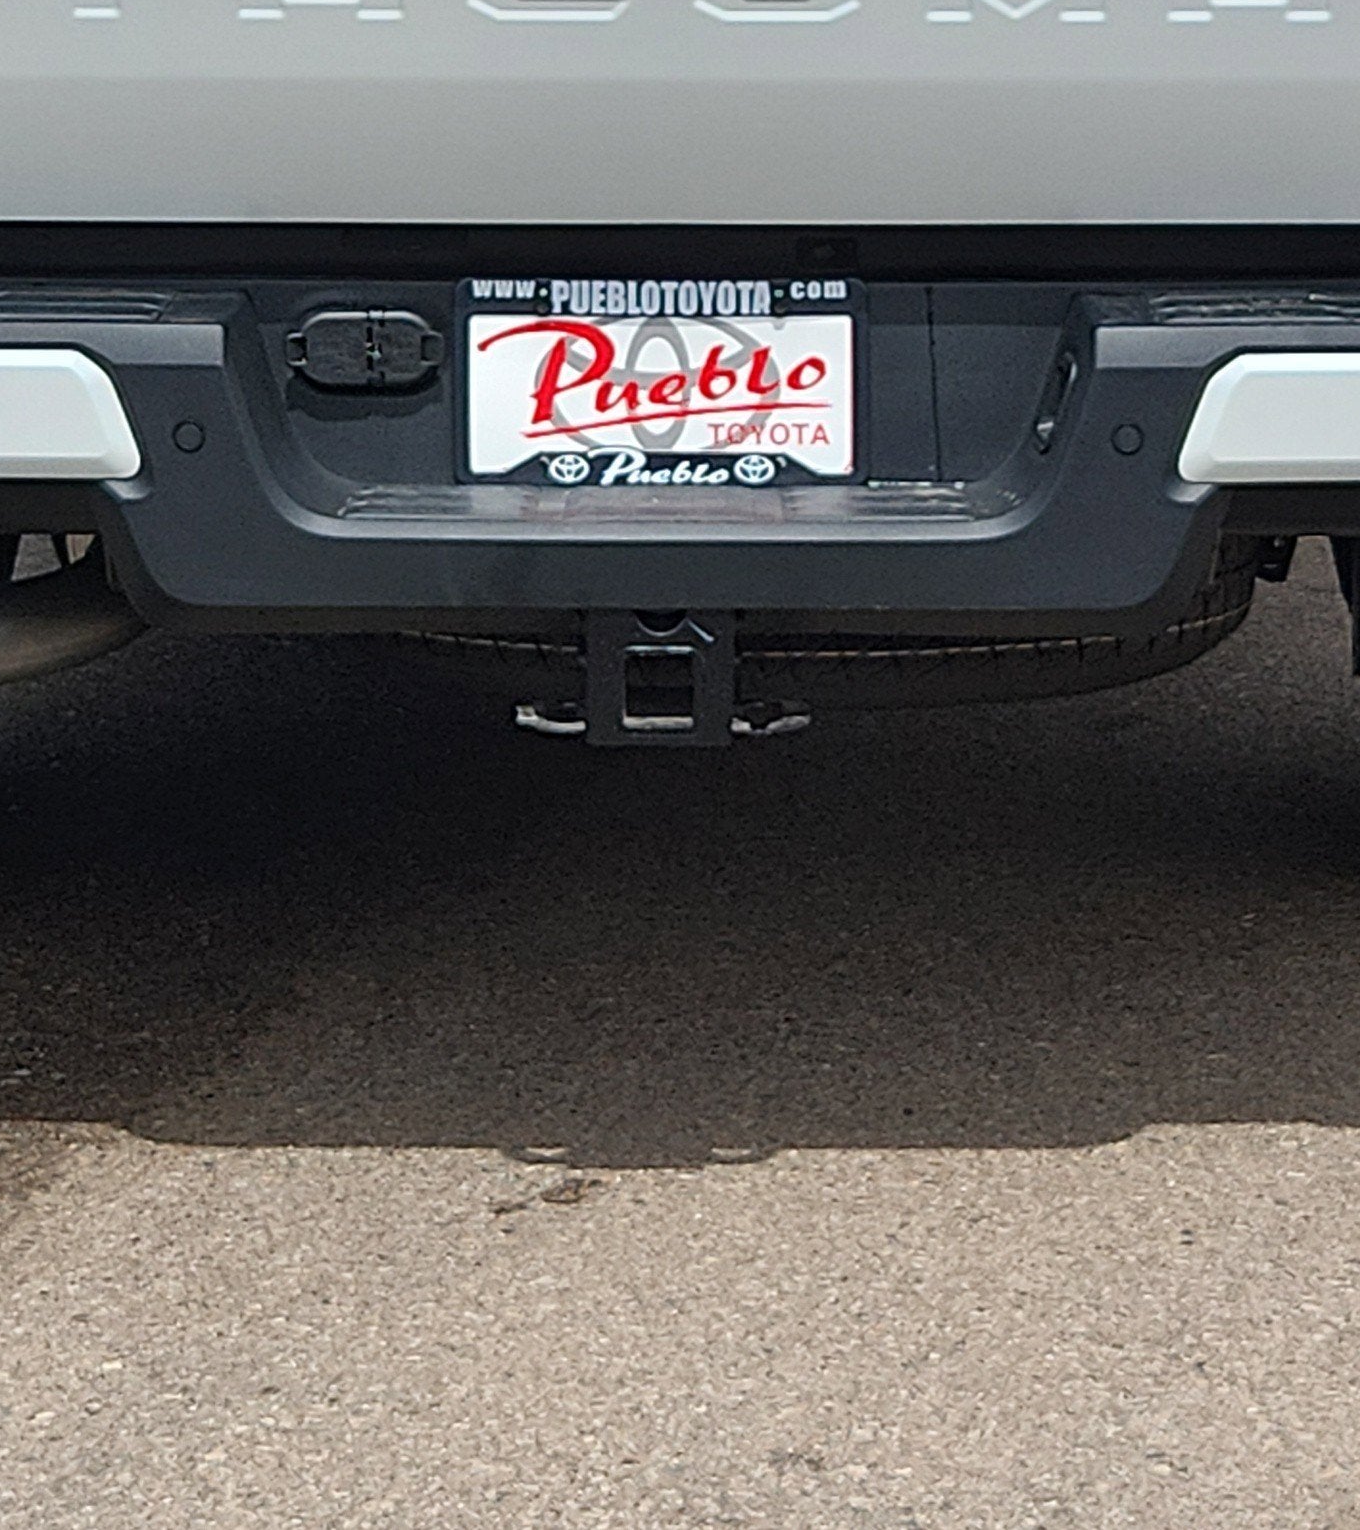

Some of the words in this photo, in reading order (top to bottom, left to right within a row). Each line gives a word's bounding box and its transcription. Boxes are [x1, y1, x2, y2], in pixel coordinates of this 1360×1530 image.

[477, 320, 827, 425] Pueblo
[707, 422, 831, 445] TOYOTA
[587, 446, 730, 486] Pueblo
